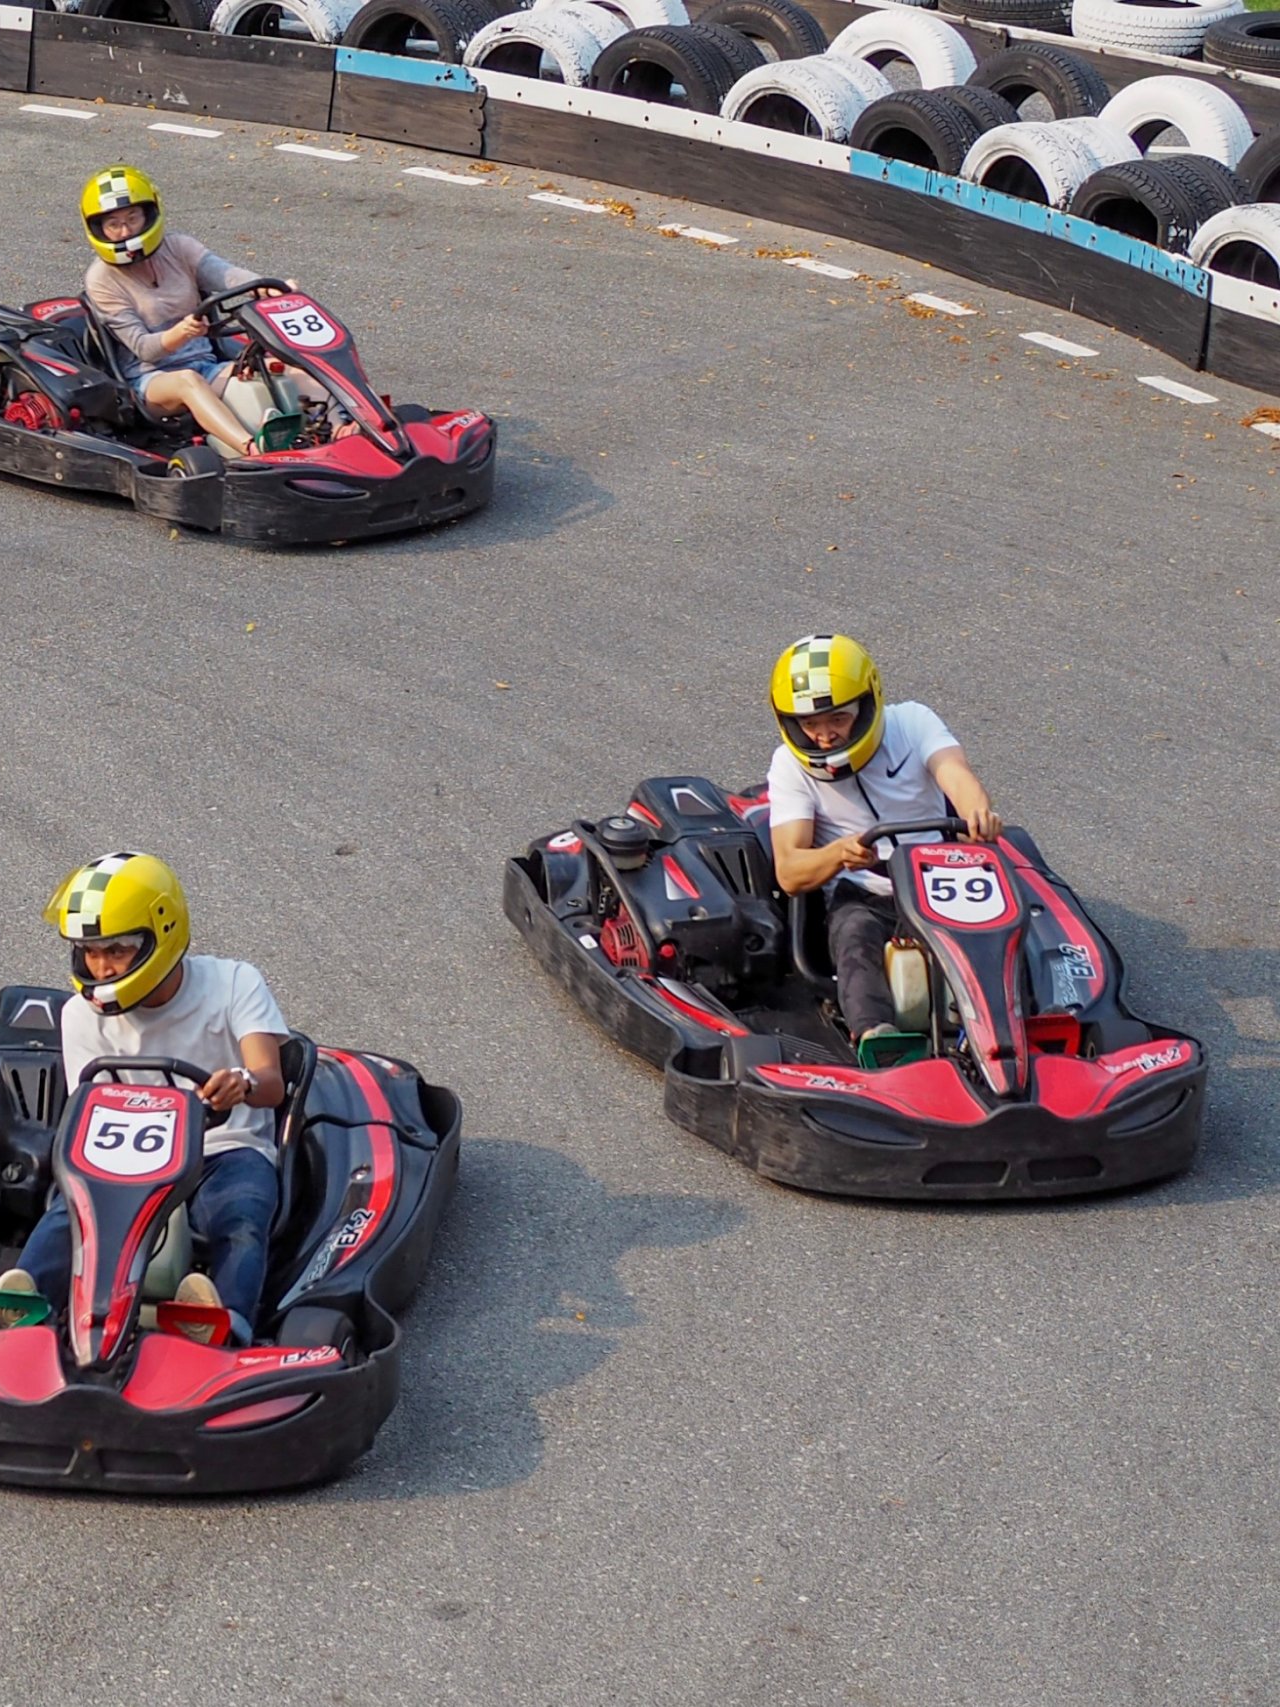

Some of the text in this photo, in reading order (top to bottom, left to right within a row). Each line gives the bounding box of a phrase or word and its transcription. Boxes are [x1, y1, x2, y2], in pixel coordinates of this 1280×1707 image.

[281, 315, 324, 336] 58
[931, 877, 993, 903] 59
[1058, 943, 1097, 979] EK-2
[93, 1122, 168, 1153] 56
[335, 1208, 376, 1247] EK-2
